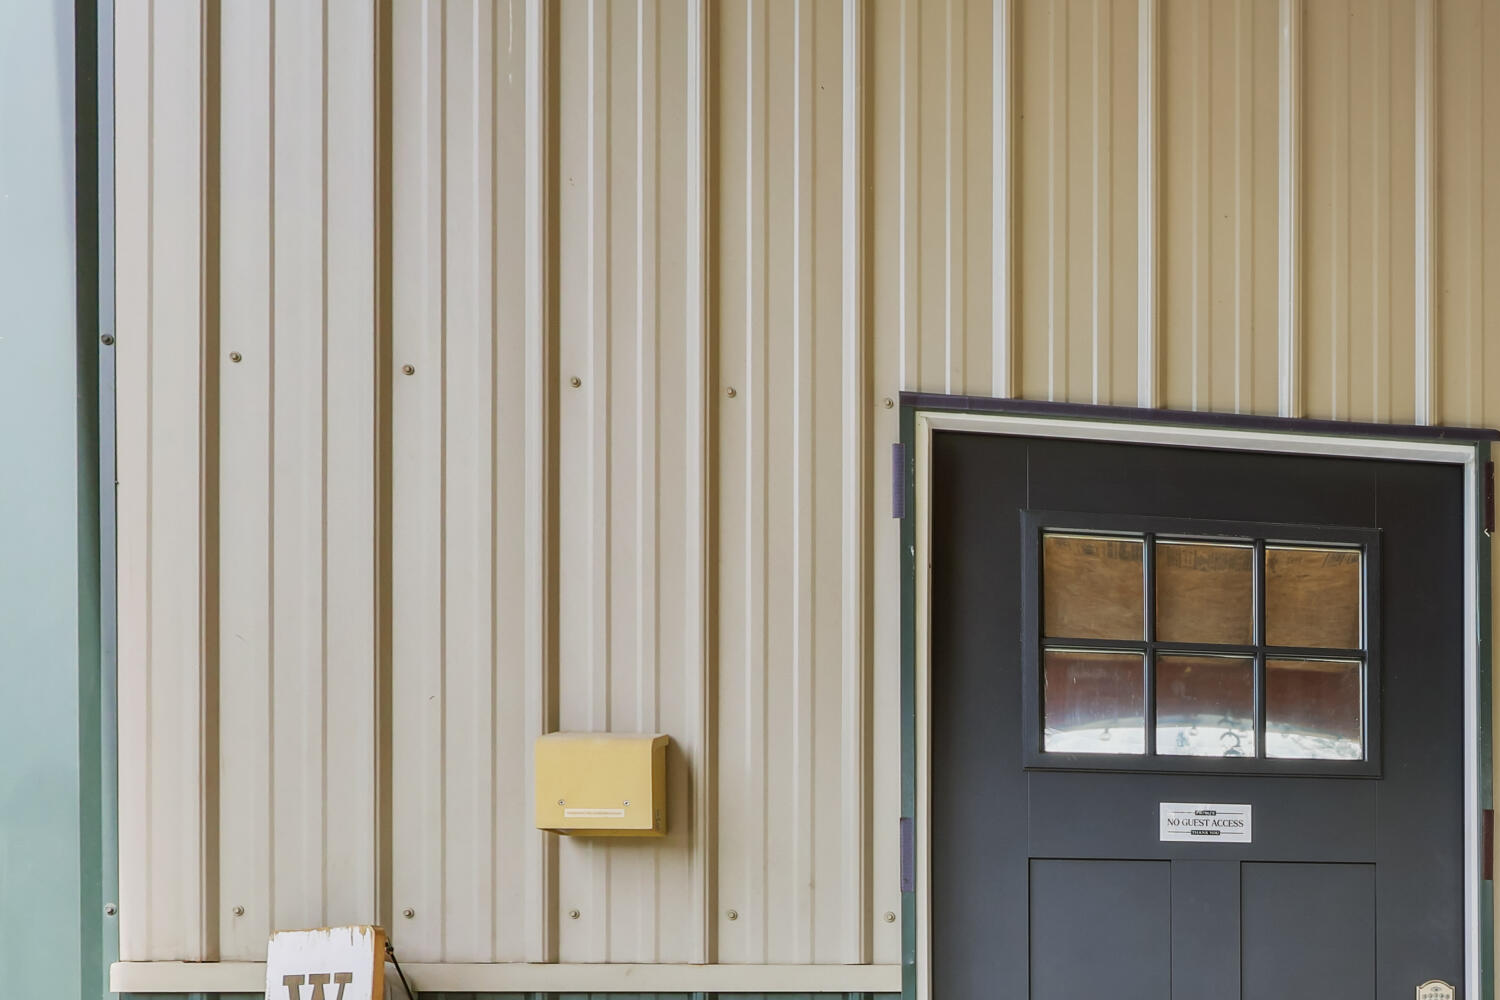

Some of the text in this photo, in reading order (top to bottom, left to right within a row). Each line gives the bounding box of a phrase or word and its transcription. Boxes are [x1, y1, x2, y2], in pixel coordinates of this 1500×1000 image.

[1167, 818, 1244, 828] NO GUEST ACCESS
